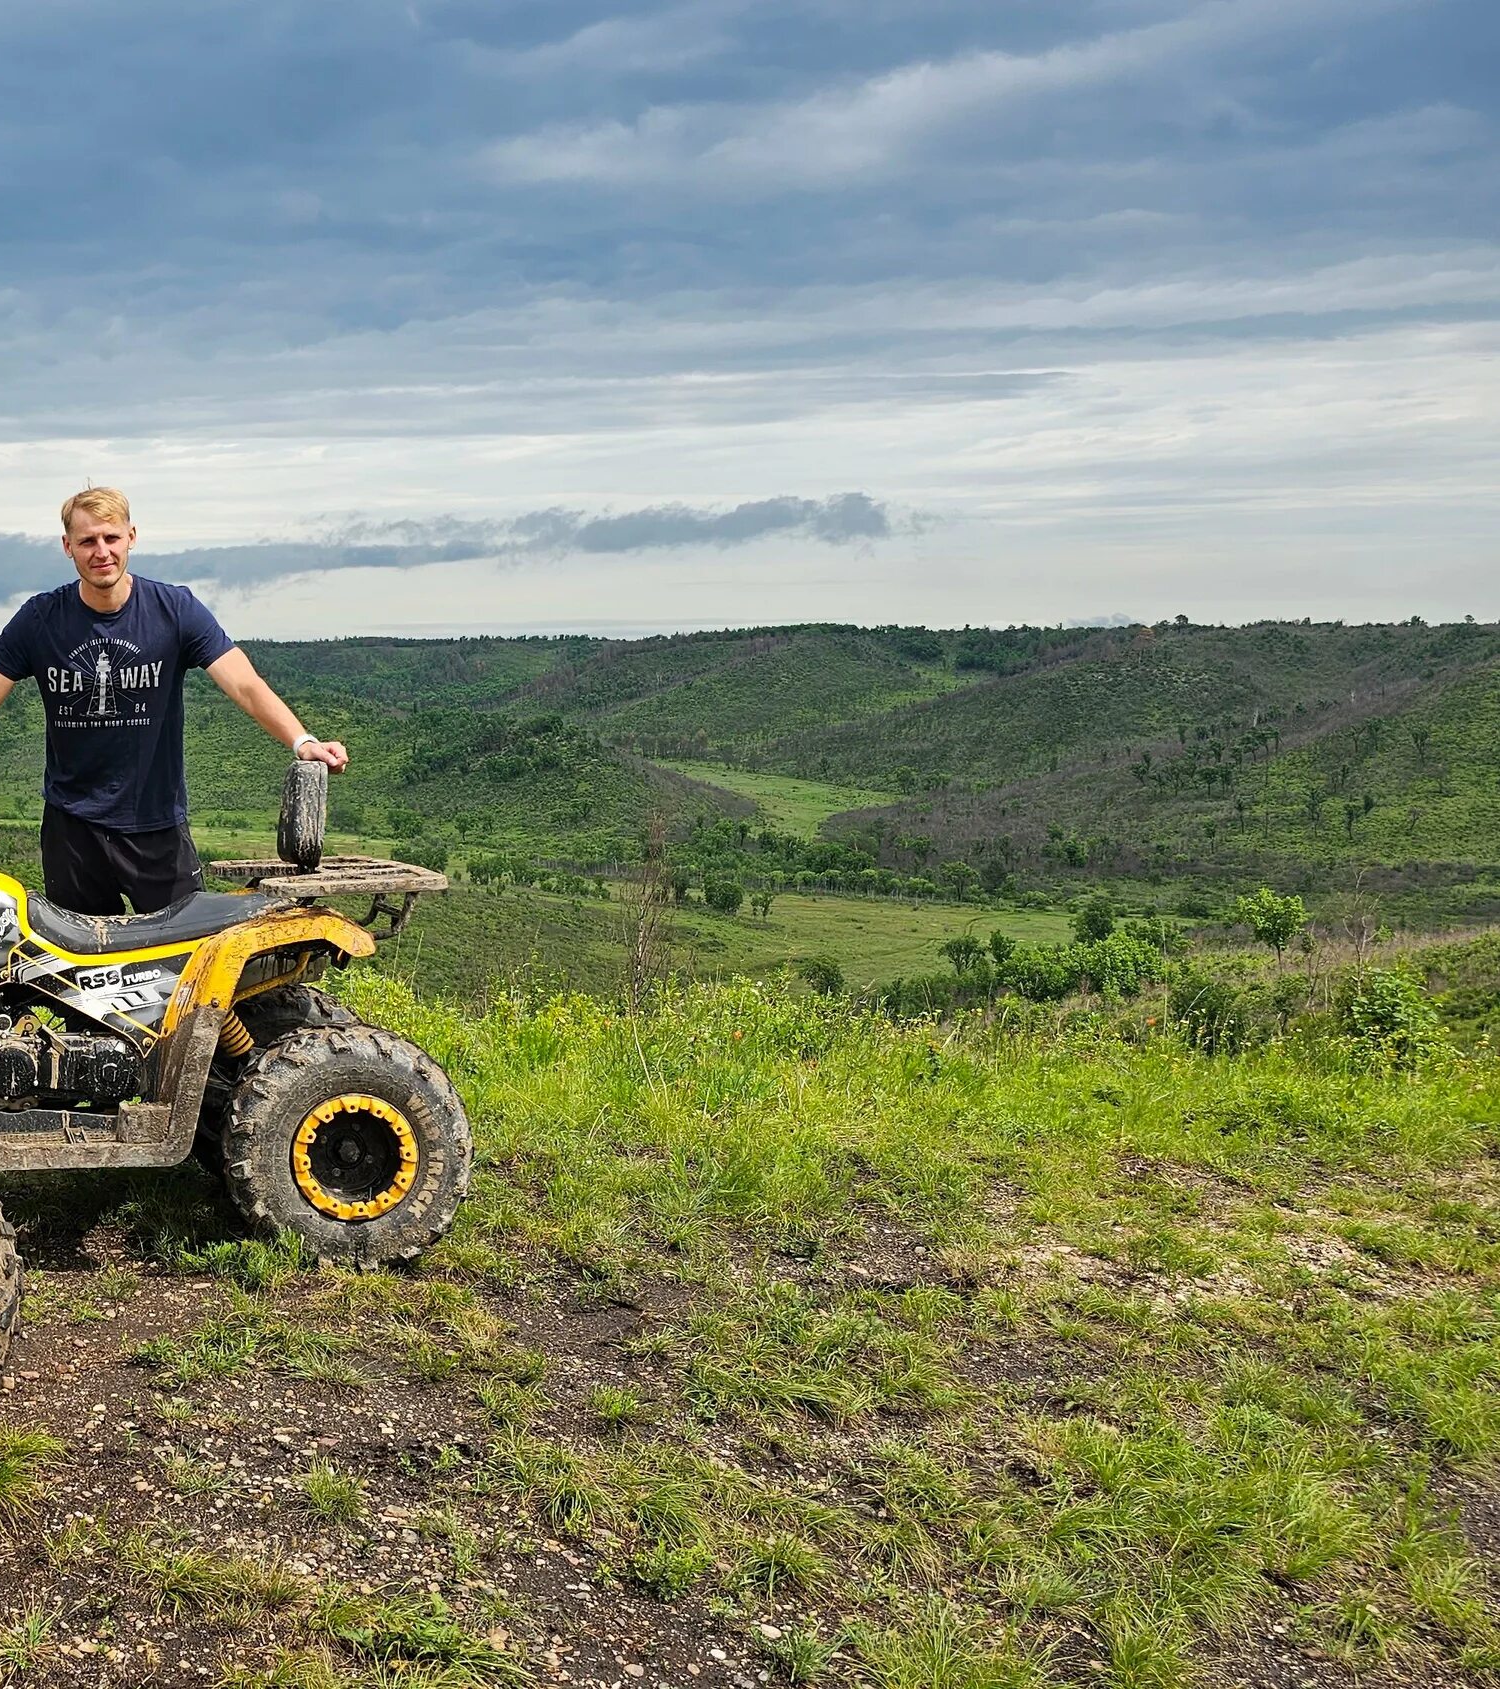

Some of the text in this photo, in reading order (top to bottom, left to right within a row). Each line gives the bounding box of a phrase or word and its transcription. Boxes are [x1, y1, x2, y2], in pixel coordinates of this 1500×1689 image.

[47, 661, 162, 692] SEA WAY
[59, 703, 146, 716] EST 84
[123, 969, 160, 985] TURBO
[408, 1148, 444, 1219] TRACK
